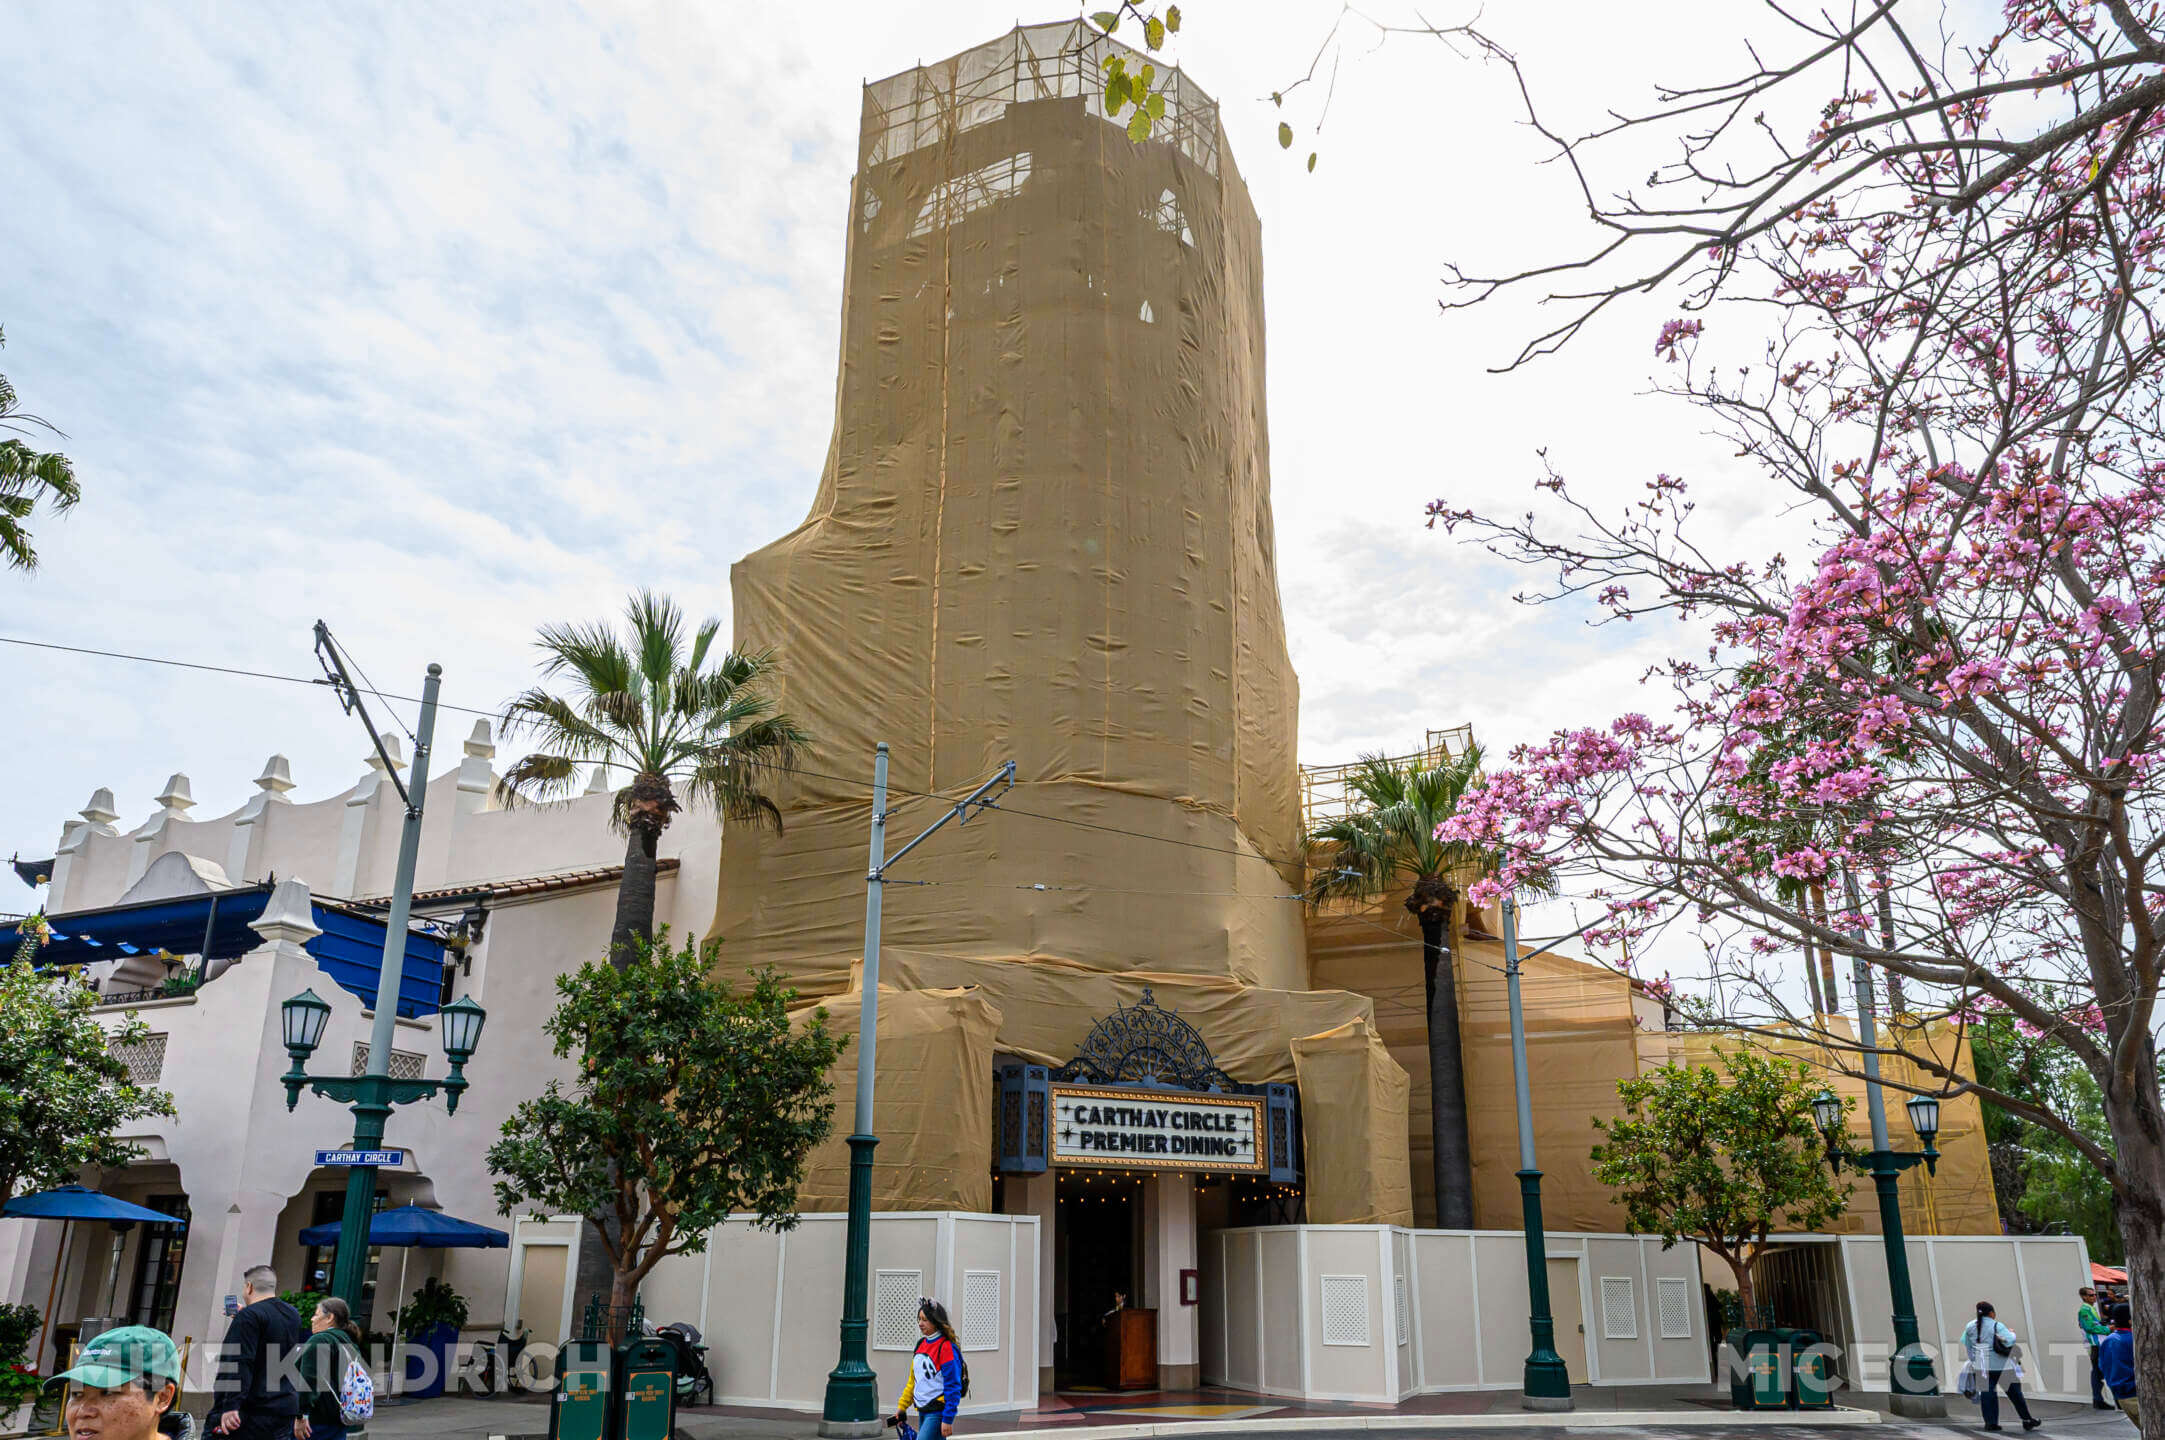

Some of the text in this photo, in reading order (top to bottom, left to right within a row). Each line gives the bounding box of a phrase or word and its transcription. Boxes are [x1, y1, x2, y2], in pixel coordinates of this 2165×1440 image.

[1074, 1105, 1237, 1132] CARTHAY CIRCLE
[1080, 1131, 1238, 1156] PREMIER DINING
[325, 1153, 392, 1163] CARTHAY CIRCLE
